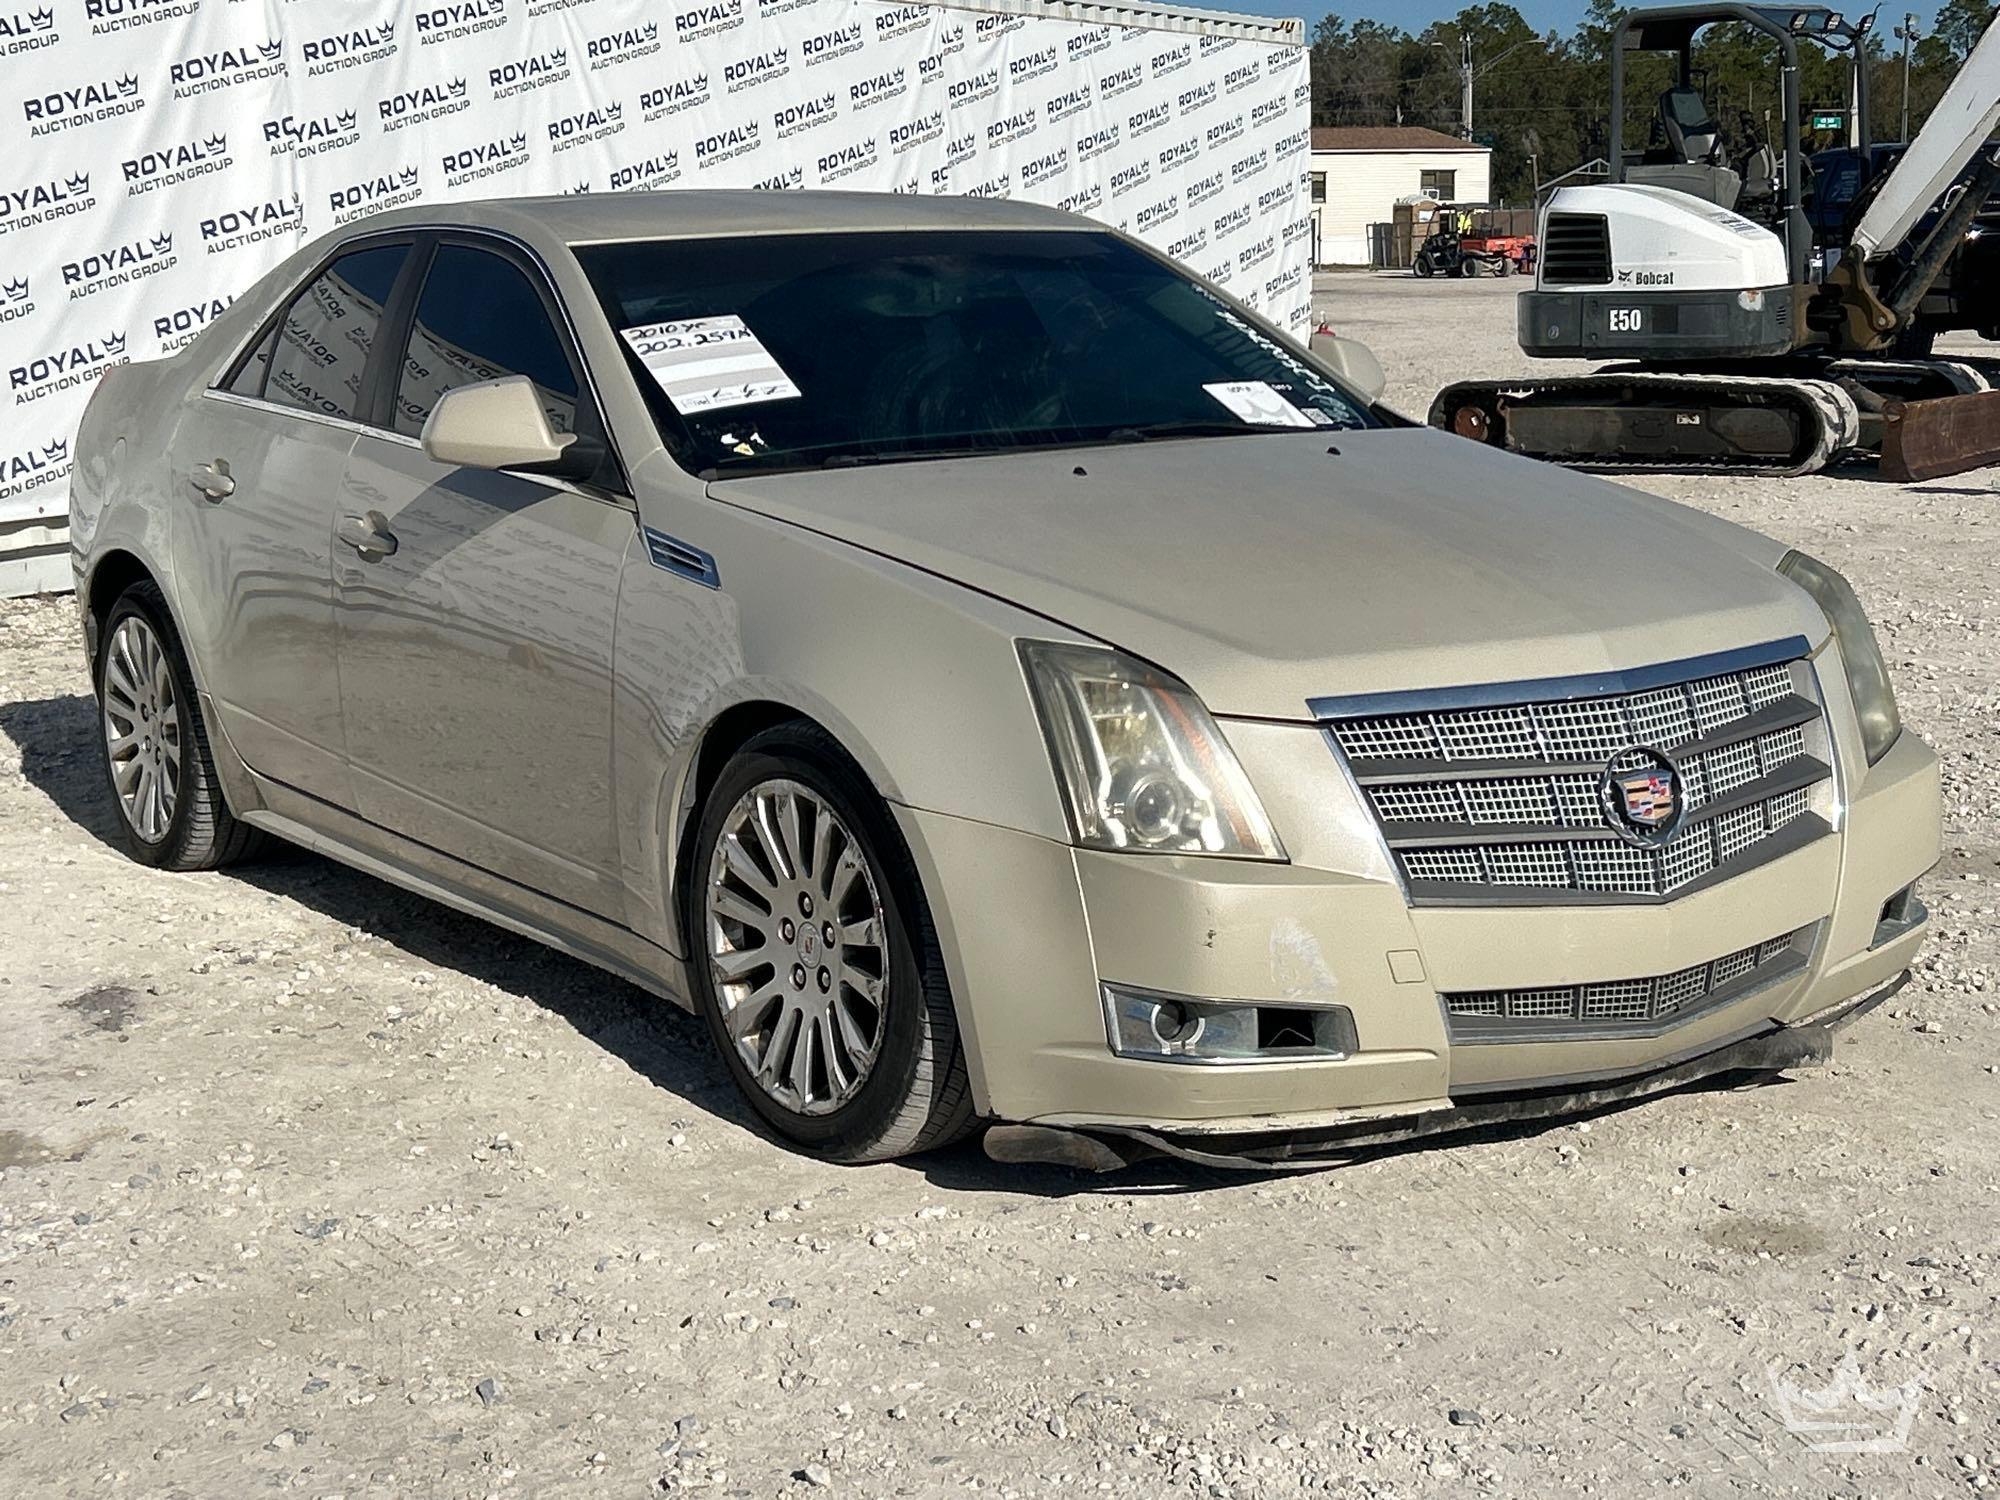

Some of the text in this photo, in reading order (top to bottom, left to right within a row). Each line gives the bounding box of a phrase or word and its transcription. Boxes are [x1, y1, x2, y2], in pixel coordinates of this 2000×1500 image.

[92, 13, 152, 35] AUCTION
[154, 1, 199, 21] GROUP
[416, 0, 488, 32] ROYAL
[528, 0, 570, 17] AUCTION
[676, 4, 728, 31] ROYAL
[761, 2, 794, 19] AUCTION
[876, 6, 919, 31] ROYAL
[422, 16, 507, 46] AUCTION GROUP
[588, 29, 644, 58] ROYAL
[679, 17, 744, 44] AUCTION GROUP
[803, 29, 850, 56] ROYAL
[879, 18, 930, 42] AUCTION GROUP
[1067, 30, 1100, 52] ROYAL
[8, 34, 59, 54] GROUP
[304, 29, 378, 62] ROYAL
[591, 43, 661, 71] AUCTION GROUP
[806, 41, 864, 67] AUCTION GROUP
[1268, 43, 1294, 66] ROYAL
[170, 47, 259, 84] ROYAL
[309, 45, 397, 77] AUCTION GROUP
[490, 55, 551, 86] ROYAL
[724, 54, 774, 82] ROYAL
[1010, 52, 1047, 74] ROYAL
[1152, 49, 1182, 70] ROYAL
[173, 62, 286, 100] AUCTION GROUP
[494, 70, 570, 100] AUCTION GROUP
[728, 66, 790, 94] AUCTION GROUP
[850, 74, 893, 100] ROYAL
[949, 75, 988, 99] ROYAL
[1101, 69, 1132, 91] ROYAL
[1224, 66, 1252, 86] ROYAL
[24, 82, 117, 121] ROYAL
[379, 85, 446, 119] ROYAL
[640, 80, 694, 110] ROYAL
[644, 94, 710, 123] AUCTION GROUP
[853, 85, 906, 112] AUCTION GROUP
[951, 85, 999, 110] AUCTION GROUP
[1048, 91, 1081, 114] ROYAL
[1179, 86, 1208, 107] ROYAL
[31, 99, 145, 138] AUCTION GROUP
[384, 100, 469, 133] AUCTION GROUP
[774, 99, 823, 128] ROYAL
[1129, 106, 1160, 130] ROYAL
[1252, 100, 1278, 120] ROYAL
[548, 109, 606, 140] ROYAL
[553, 122, 625, 154] AUCTION GROUP
[777, 112, 837, 139] AUCTION GROUP
[890, 117, 931, 144] ROYAL
[987, 114, 1025, 140] ROYAL
[1207, 120, 1235, 142] ROYAL
[270, 133, 360, 159] AUCION GROUP
[696, 127, 746, 158] ROYAL
[893, 123, 944, 155] AUCTION GROUP
[988, 133, 1016, 150] AUCTION
[1078, 130, 1110, 153] ROYAL
[1275, 133, 1301, 154] ROYAL
[122, 142, 206, 181] ROYAL
[444, 140, 511, 174] ROYAL
[699, 140, 761, 170] AUCTION GROUP
[818, 144, 864, 173] ROYAL
[1022, 154, 1058, 179] ROYAL
[1160, 142, 1190, 164] ROYAL
[1232, 154, 1259, 176] ROYAL
[128, 158, 233, 197] AUCTION GROUP
[448, 154, 530, 188] AUCTION GROUP
[610, 158, 664, 189] ROYAL
[652, 170, 681, 188] GROUP
[821, 155, 878, 184] AUCTION GROUP
[1110, 165, 1140, 189] ROYAL
[0, 182, 66, 216] OYAL
[331, 175, 400, 211] ROYAL
[1187, 176, 1215, 199] ROYAL
[1259, 186, 1285, 208] ROYAL
[45, 198, 96, 221] GROUP
[200, 199, 294, 240] ROYAL
[335, 188, 422, 225] AUCTION GROUP
[1137, 201, 1168, 225] ROYAL
[1215, 210, 1242, 232] ROYAL
[207, 227, 271, 255] AUCTION
[1168, 234, 1198, 256] ROYAL
[1239, 241, 1266, 264] ROYAL
[63, 242, 151, 285] ROYAL
[70, 257, 177, 301] AUCTION GROUP
[1266, 271, 1292, 293] ROYAL
[1636, 271, 1674, 285] Bobcat
[155, 296, 234, 338] ROYA
[1290, 303, 1311, 323] ROYA
[1609, 309, 1642, 331] E50
[629, 324, 678, 341] 2010
[9, 344, 103, 390] ROYAL
[16, 374, 80, 405] AUCTION
[25, 463, 75, 490] GROUP
